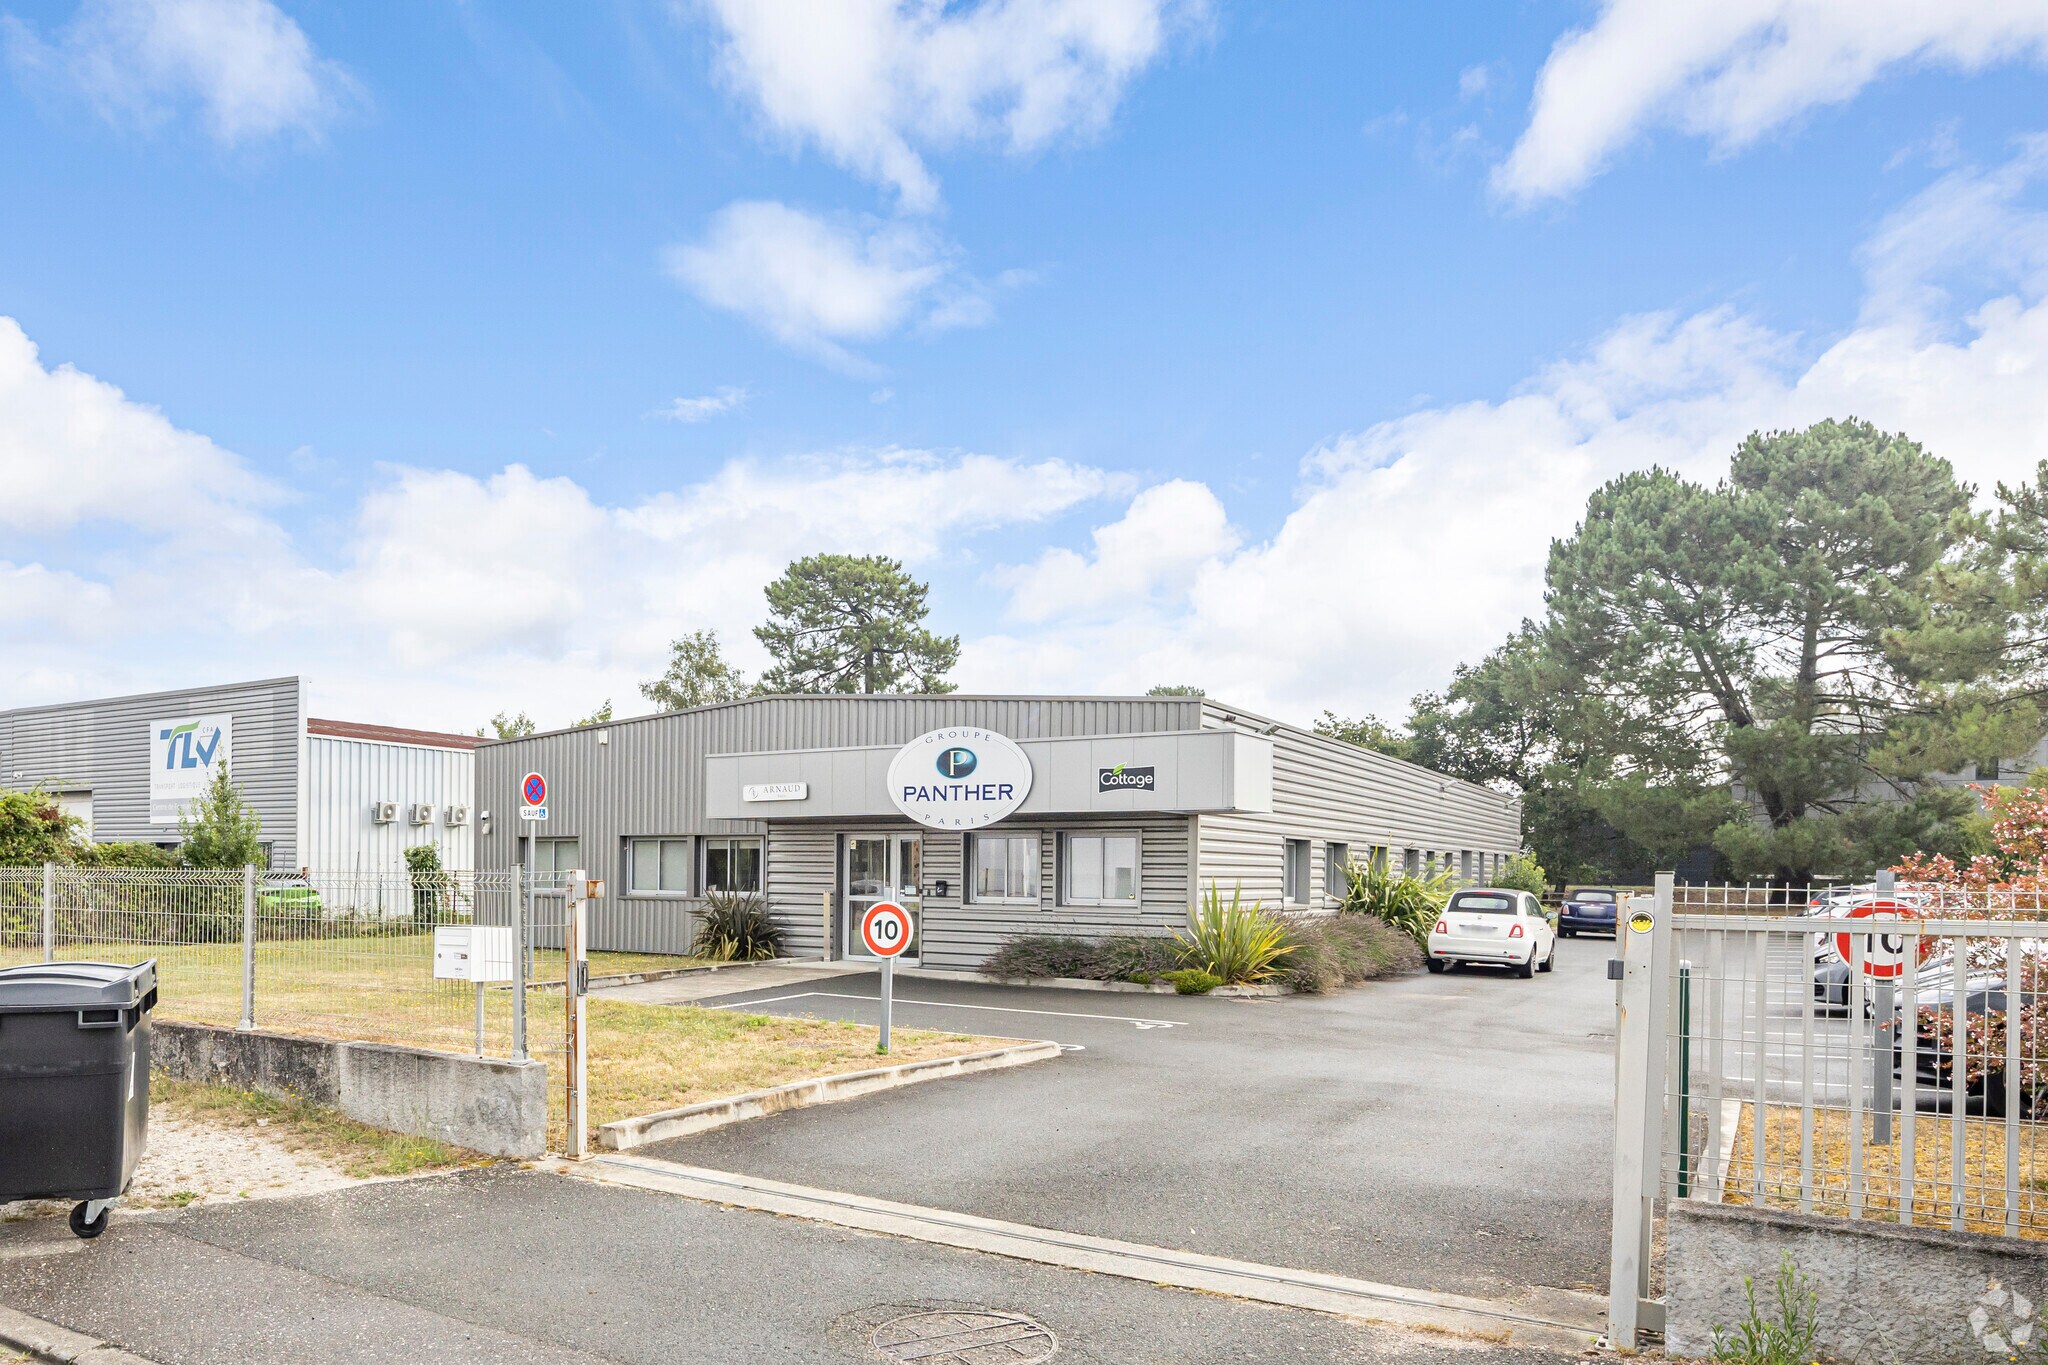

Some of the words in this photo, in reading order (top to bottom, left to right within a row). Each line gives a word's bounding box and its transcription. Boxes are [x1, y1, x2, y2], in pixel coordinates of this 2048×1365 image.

[202, 726, 214, 734] CFA
[925, 730, 991, 744] GROUPE
[160, 726, 222, 769] TLV
[949, 750, 968, 776] P
[1100, 772, 1153, 788] Cottage
[763, 784, 801, 793] ARNAUD
[903, 784, 1014, 802] PANTHER
[924, 814, 990, 826] PARIS
[874, 919, 898, 941] 10
